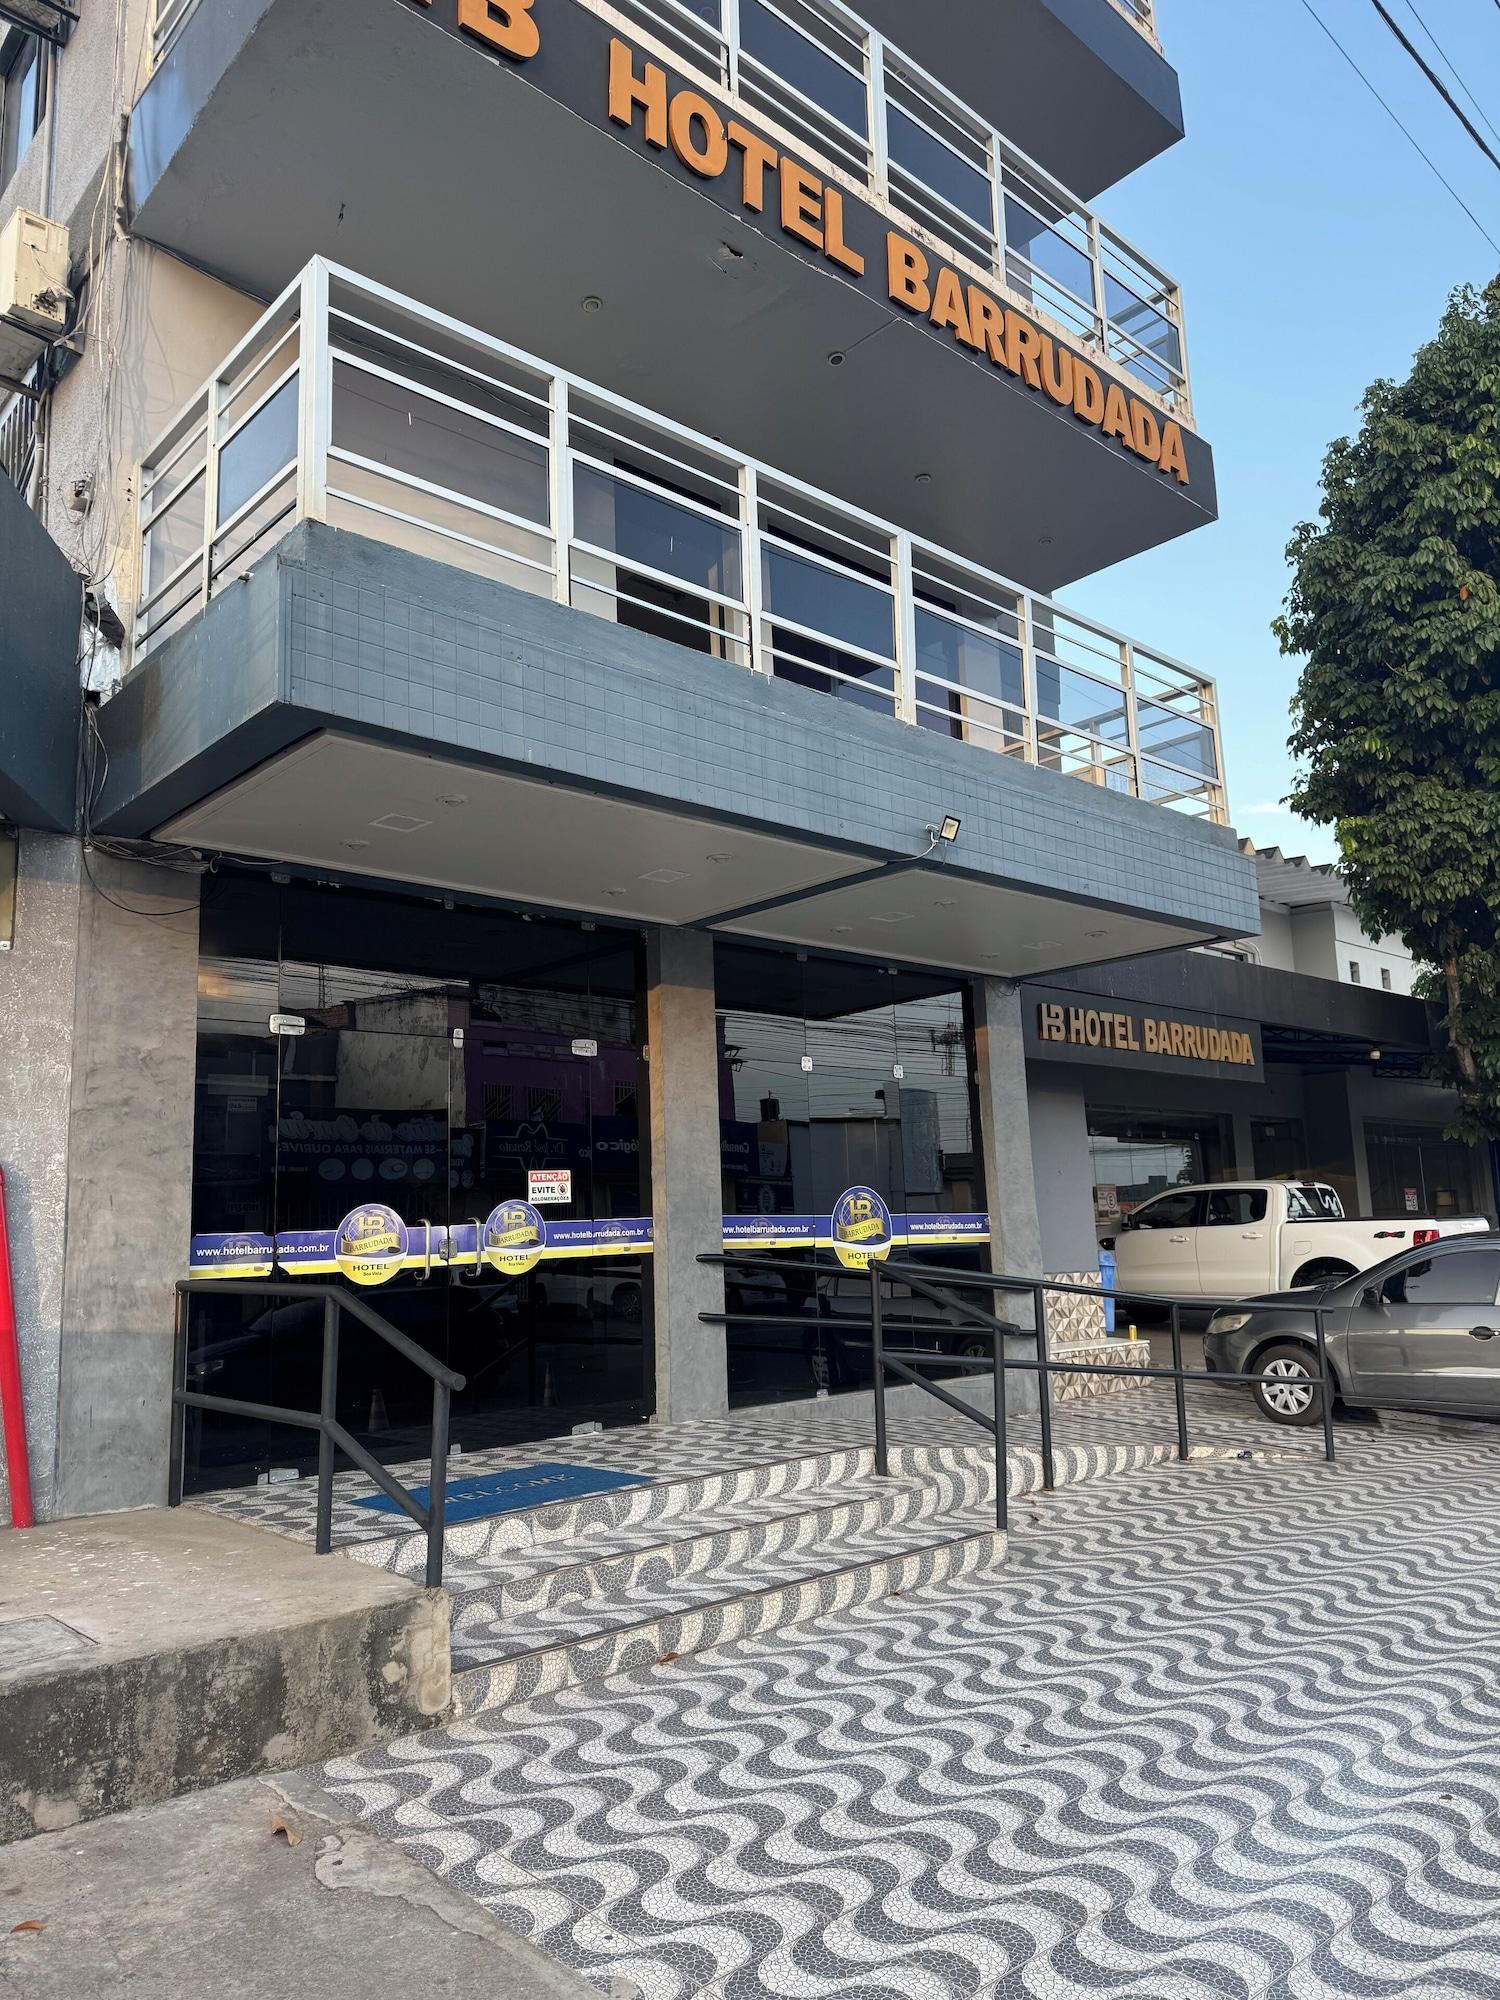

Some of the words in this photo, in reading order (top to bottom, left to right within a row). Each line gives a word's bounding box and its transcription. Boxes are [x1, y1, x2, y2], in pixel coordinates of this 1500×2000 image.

[410, 0, 539, 60] B
[609, 37, 865, 278] HOTEL
[887, 230, 1190, 486] BARRUDADA
[1068, 1006, 1140, 1050] HOTEL
[1143, 1017, 1256, 1066] BARRUDADA
[531, 1186, 556, 1194] EVITE
[722, 1225, 809, 1234] ww.hotelbarrudada.com.br
[910, 1222, 983, 1231] www.hotelbarrudada.com.br
[196, 1244, 329, 1257] www.hotelbarruada.com.br
[847, 1252, 879, 1260] HOTEL
[352, 1264, 390, 1272] HOTEL
